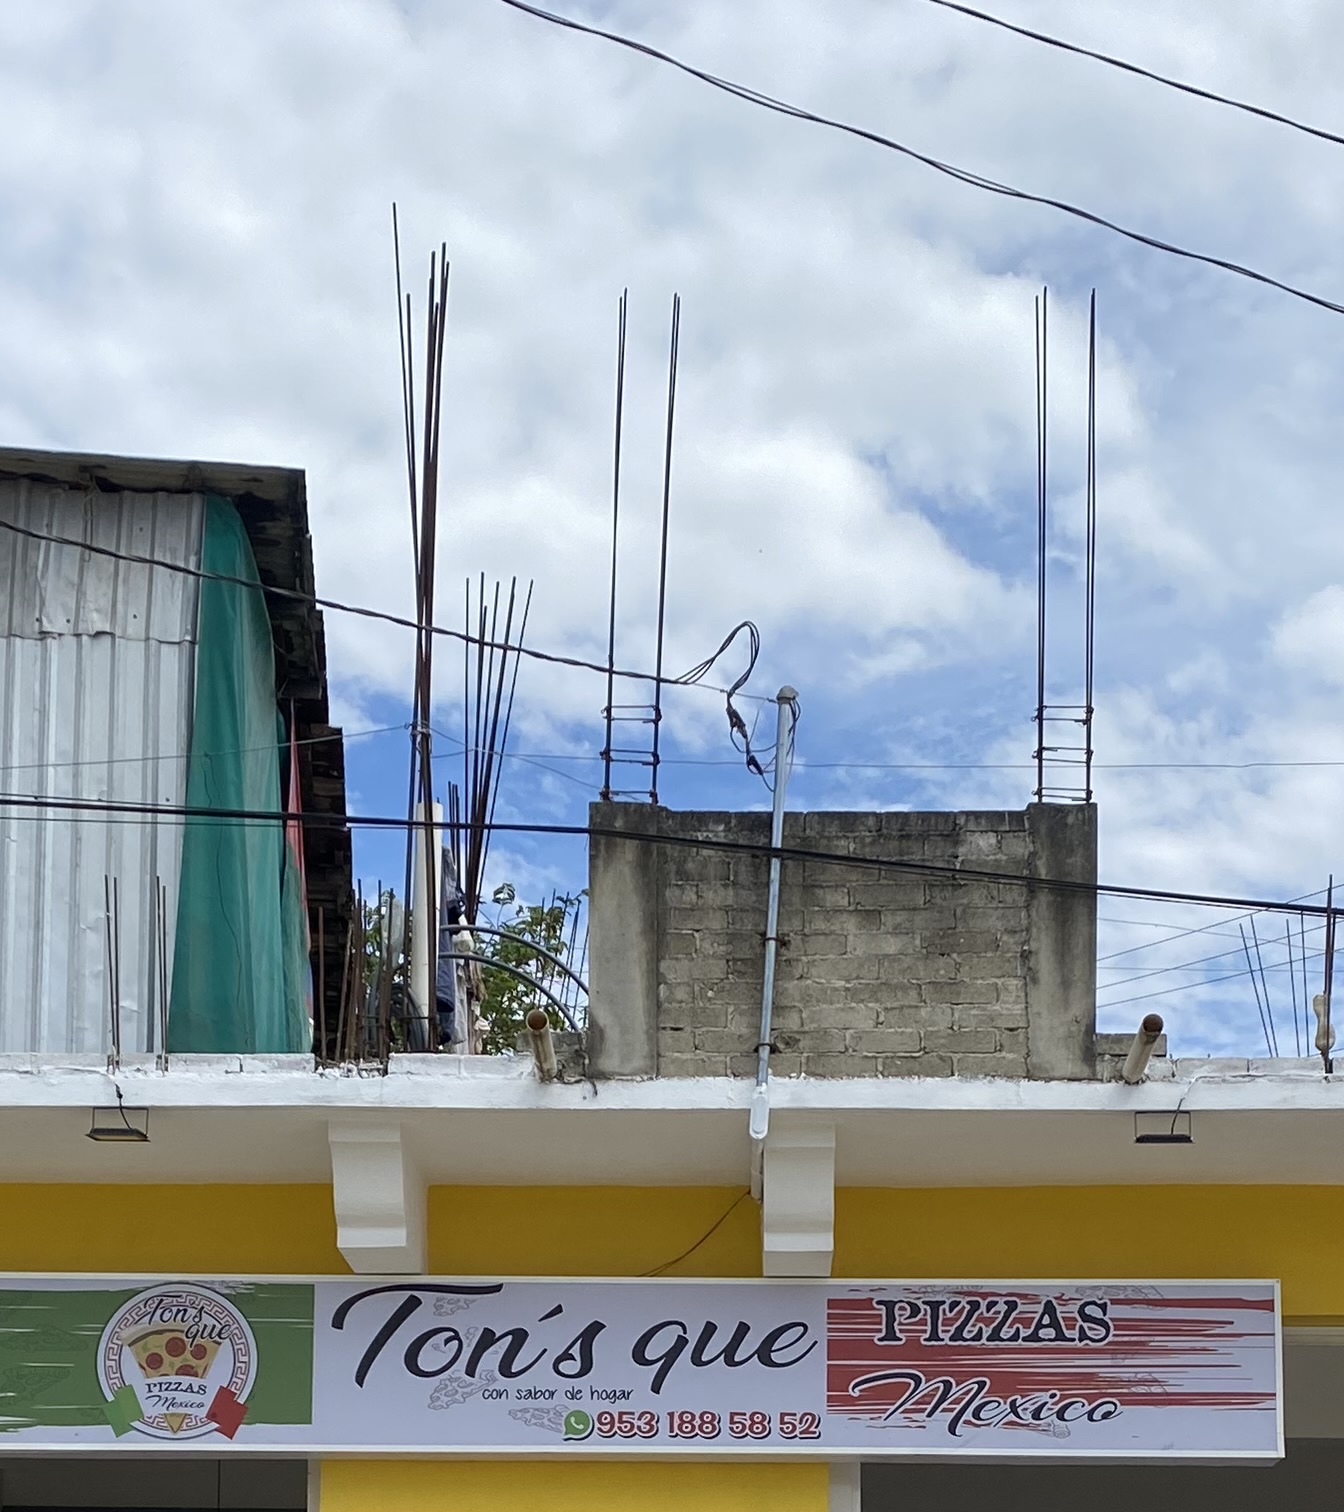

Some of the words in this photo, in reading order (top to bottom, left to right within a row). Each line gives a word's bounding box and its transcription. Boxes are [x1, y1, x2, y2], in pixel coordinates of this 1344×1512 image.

[875, 1299, 1112, 1343] PIZZAS
[185, 1323, 232, 1348] que
[331, 1283, 607, 1388] Ton's
[631, 1319, 818, 1395] que
[146, 1382, 207, 1395] PIZZAS
[482, 1389, 509, 1400] con
[516, 1386, 558, 1400] sabor
[565, 1386, 583, 1400] de
[590, 1386, 634, 1404] hogar
[146, 1395, 205, 1411] Mexico
[851, 1371, 1123, 1437] Mexico
[596, 1410, 658, 1438] 953
[667, 1410, 720, 1438] 188
[728, 1411, 771, 1439] 58
[779, 1411, 821, 1439] 52
